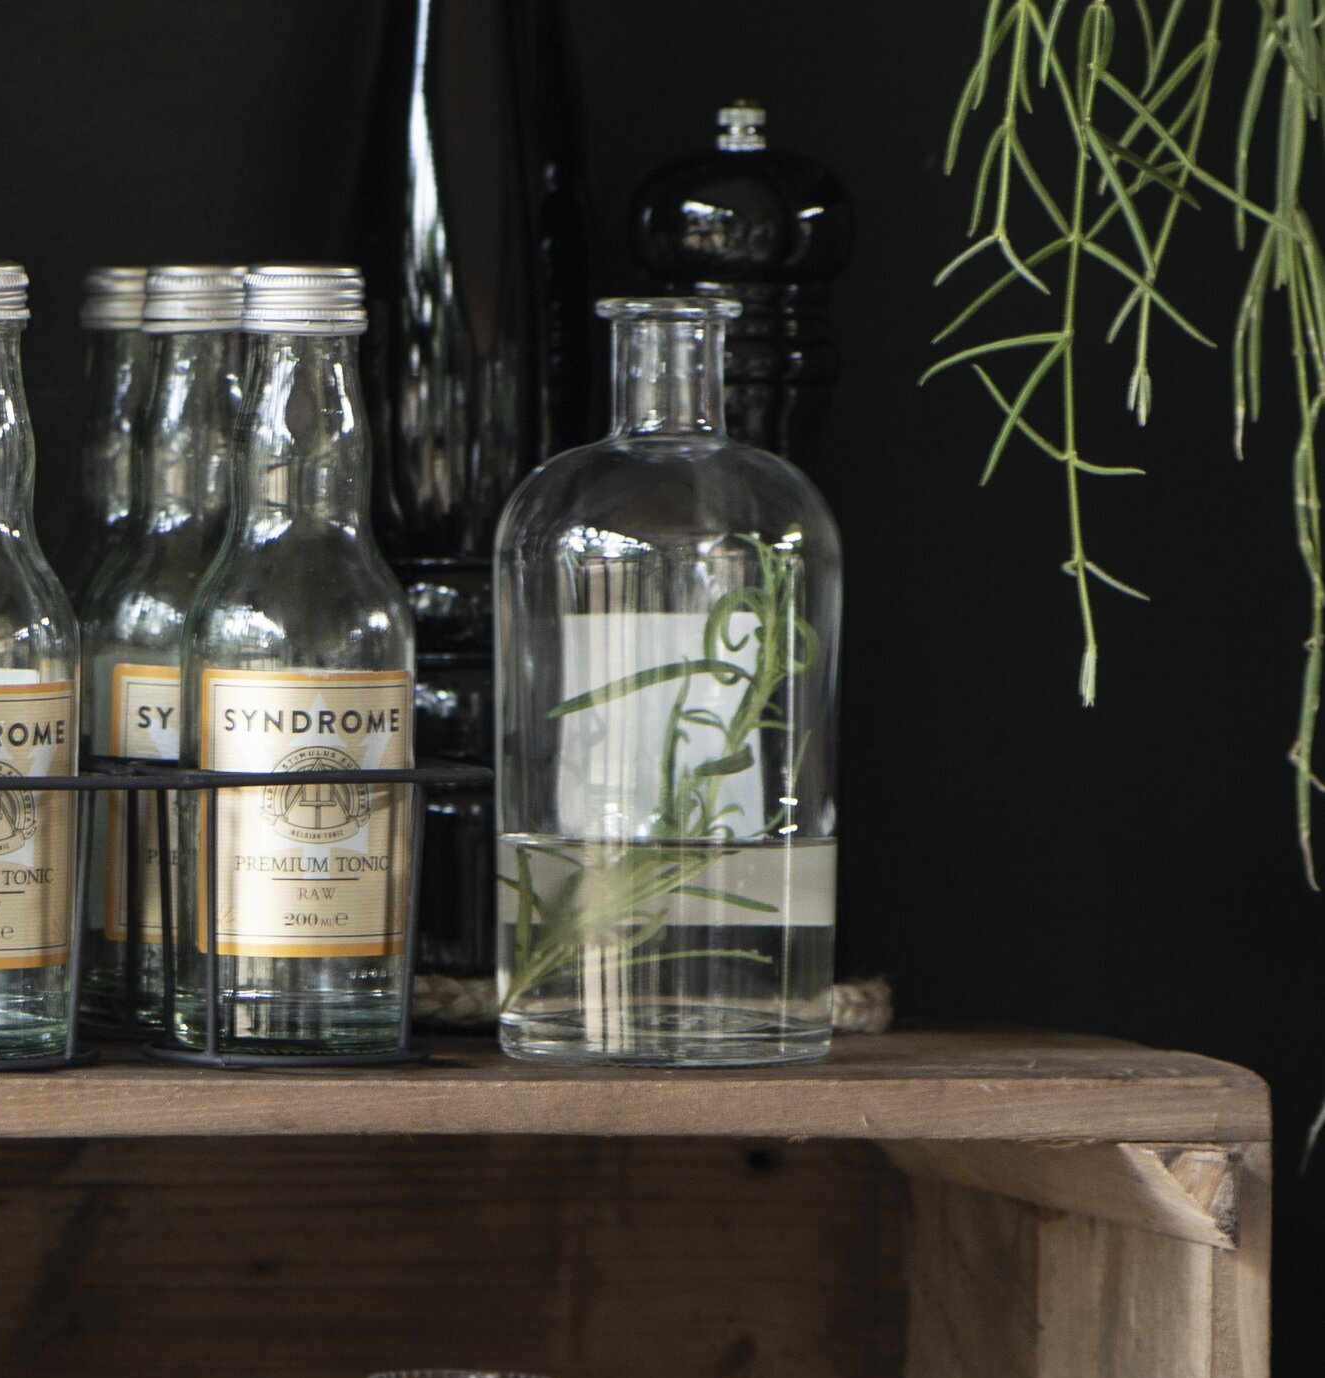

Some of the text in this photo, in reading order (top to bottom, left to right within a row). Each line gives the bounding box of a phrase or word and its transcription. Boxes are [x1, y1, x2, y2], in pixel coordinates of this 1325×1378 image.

[224, 708, 400, 734] SYNDROME
[324, 829, 345, 839] TONIC
[234, 855, 389, 873] PREMIUM TONIC
[1, 867, 54, 886] TONIC
[298, 887, 336, 901] RAW
